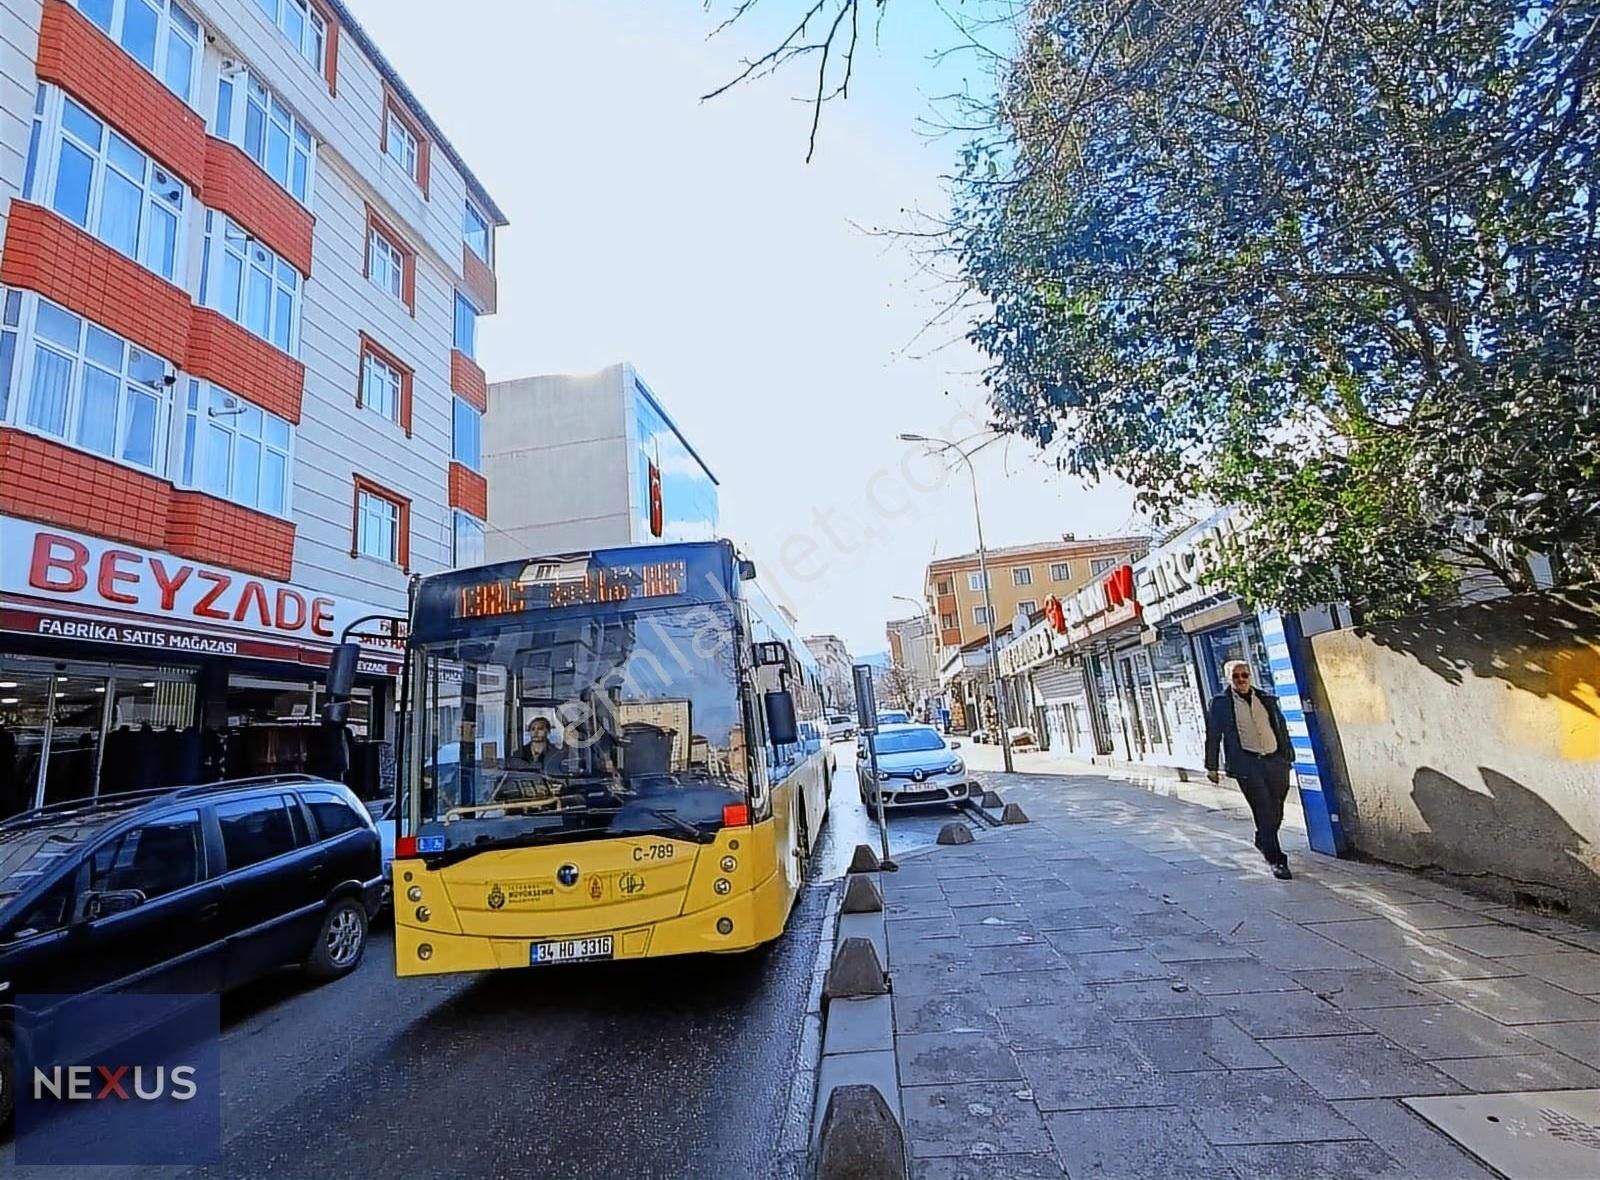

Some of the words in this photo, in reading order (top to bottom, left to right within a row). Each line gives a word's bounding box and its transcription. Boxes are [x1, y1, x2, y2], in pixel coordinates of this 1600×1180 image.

[29, 532, 336, 638] BEYZADE
[39, 618, 118, 641] FABRİKA
[169, 635, 237, 654] MAĞAZASI
[357, 660, 388, 673] EYZADE
[632, 843, 674, 862] C-789
[539, 944, 554, 960] 34
[581, 938, 611, 955] 3316
